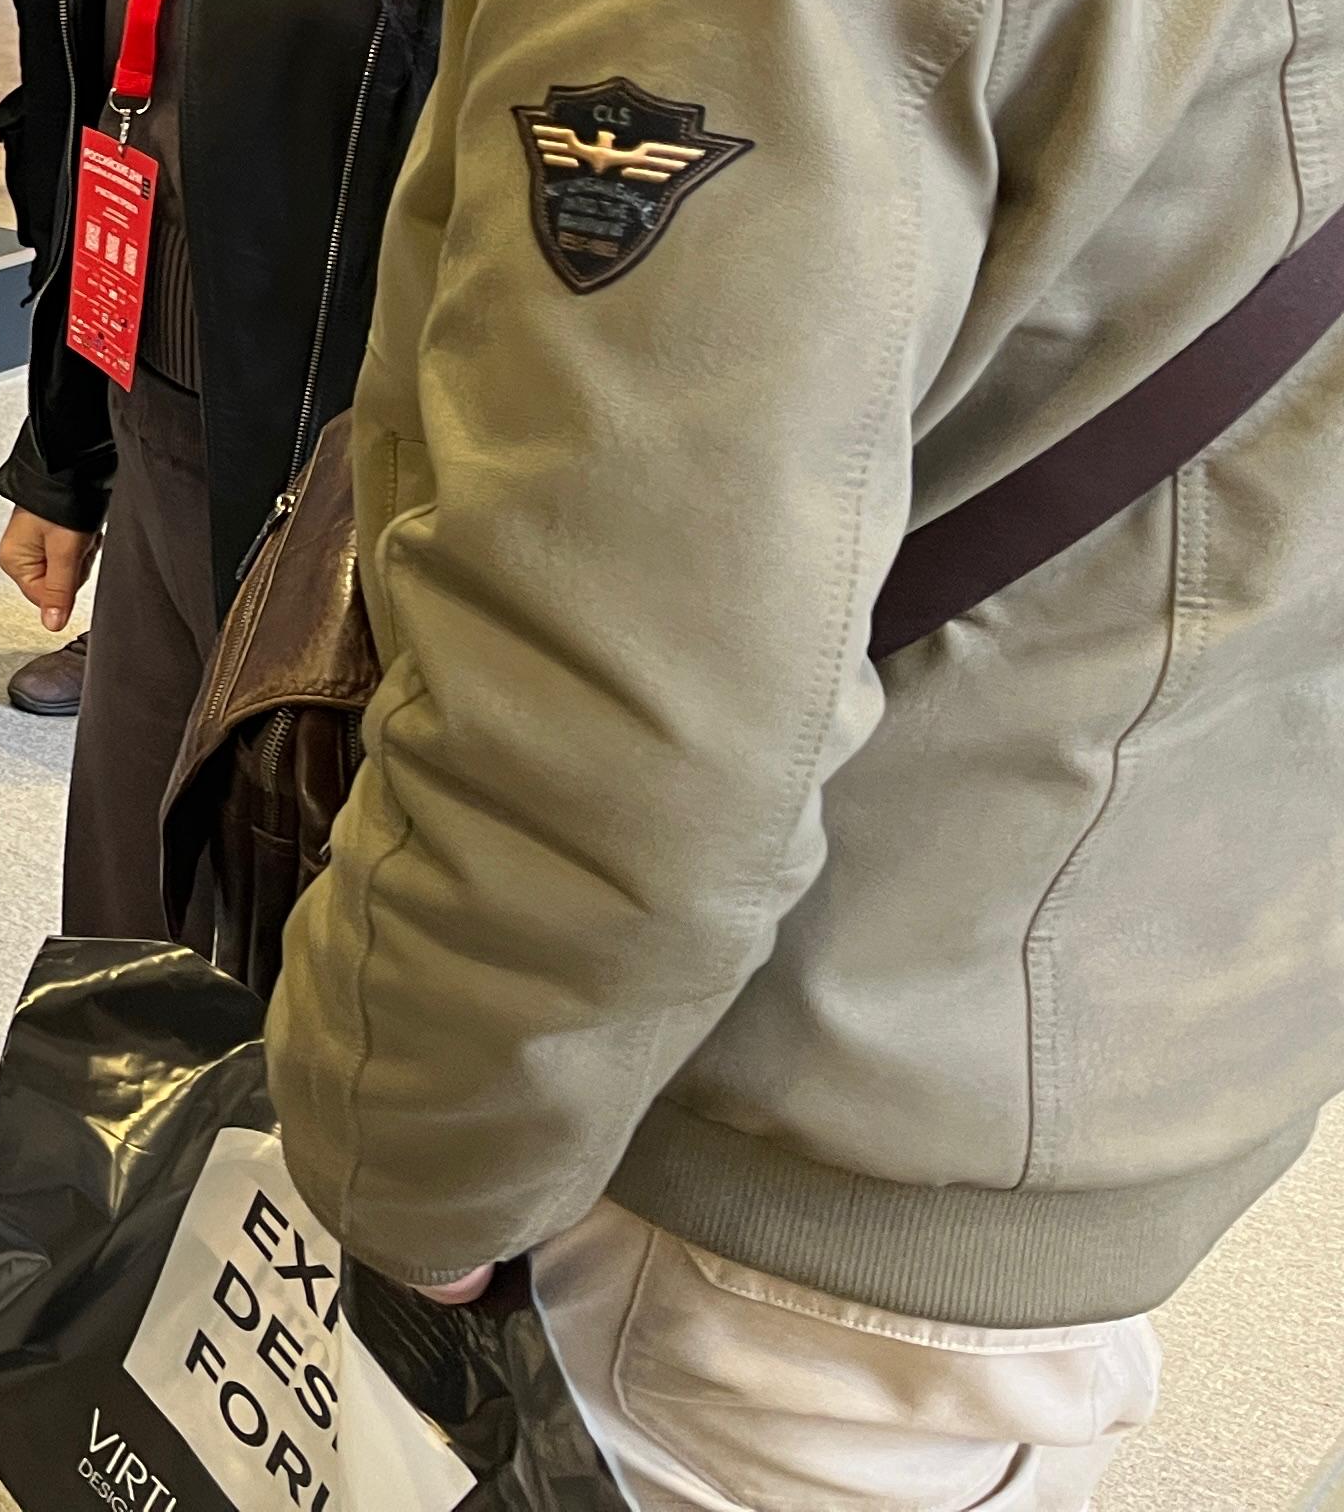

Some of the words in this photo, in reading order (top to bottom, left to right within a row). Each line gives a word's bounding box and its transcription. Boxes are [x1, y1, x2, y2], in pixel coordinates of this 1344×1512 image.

[241, 1189, 340, 1335] EX
[185, 1328, 331, 1512] FOR
[213, 1259, 339, 1454] DES
[78, 1457, 135, 1512] DESIG
[89, 1407, 178, 1512] VIRT
